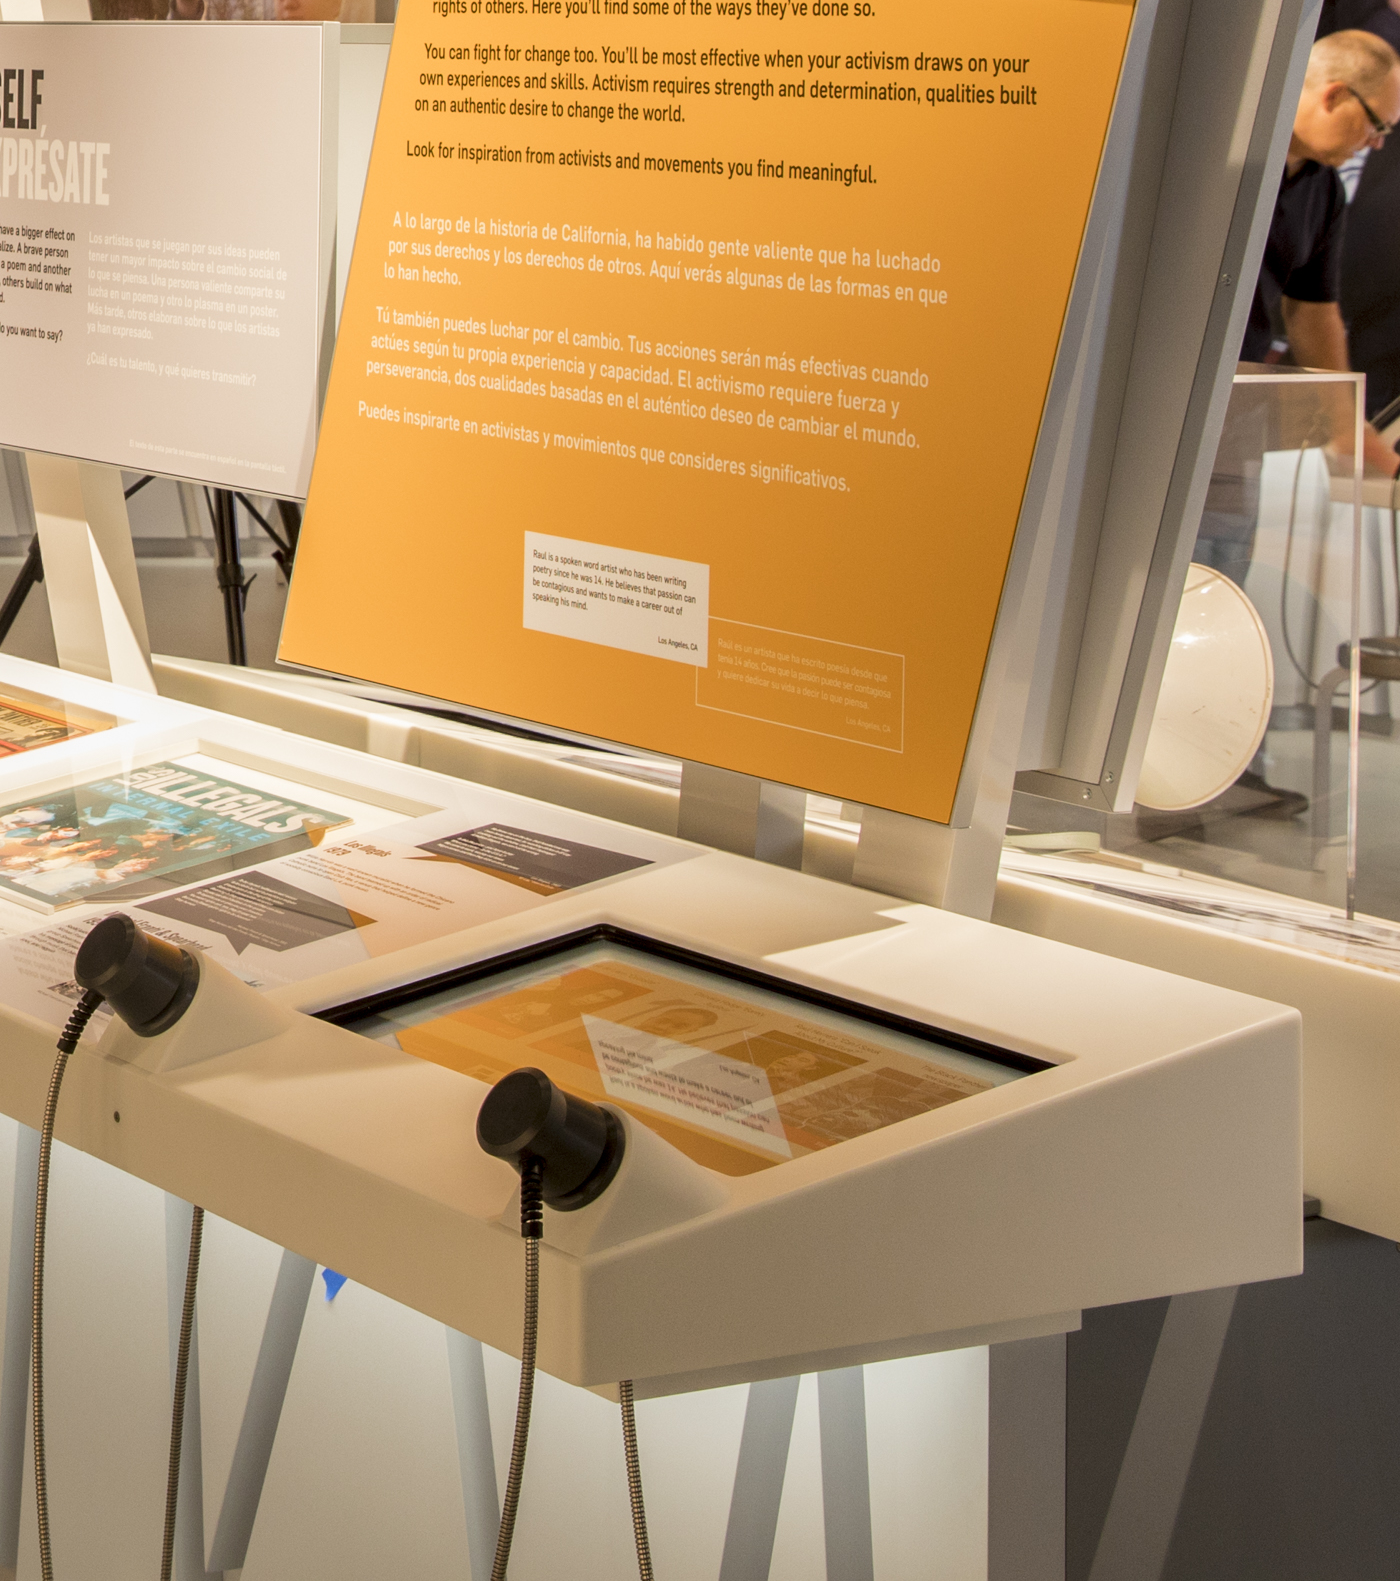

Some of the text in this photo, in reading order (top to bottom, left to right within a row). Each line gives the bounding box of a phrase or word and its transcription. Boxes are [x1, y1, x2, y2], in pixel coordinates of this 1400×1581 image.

[632, 1, 670, 16] some
[715, 1, 753, 21] ways
[853, 2, 876, 17] so.
[424, 42, 1031, 78] You can fight for change too. You'll be most effective when your activism draws on your
[419, 70, 1038, 107] own experiences and skills. Activism requires strength and determination, qualities built
[414, 96, 686, 124] on an authentic desire to change the world.
[406, 139, 877, 188] Look for inspiration from activists and movements you find meaningful.
[383, 261, 462, 286] lo han hecho.
[6, 326, 18, 336] you
[20, 327, 37, 338] want
[38, 328, 45, 339] to
[47, 330, 63, 343] say?
[668, 639, 689, 650] Angeles,
[690, 643, 698, 651] CA
[133, 769, 326, 834] ILLEGALS
[200, 817, 271, 843] EXILE
